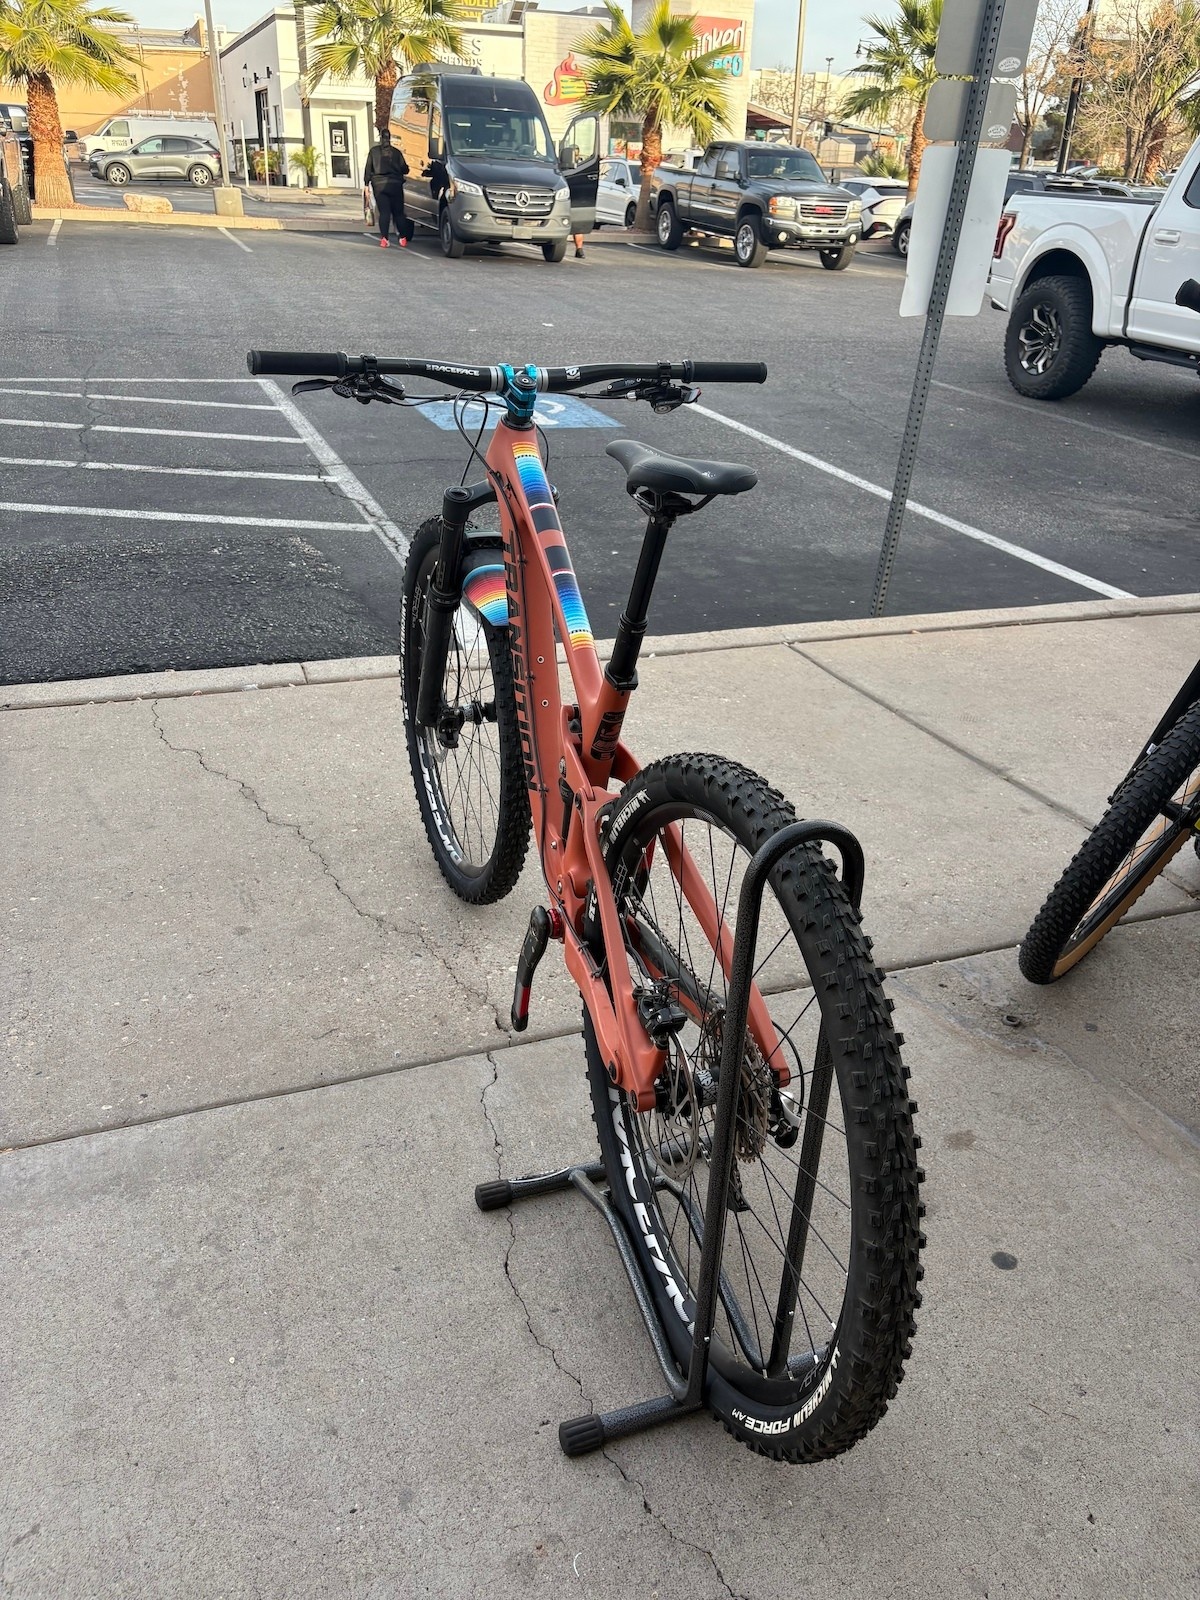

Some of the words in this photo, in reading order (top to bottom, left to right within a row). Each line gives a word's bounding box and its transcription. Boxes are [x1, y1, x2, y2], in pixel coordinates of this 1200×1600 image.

[503, 529, 538, 792] TRANSITION
[609, 797, 641, 845] MICHELIN
[793, 1365, 834, 1429] MICHELIN
[744, 1416, 791, 1435] FORCE
